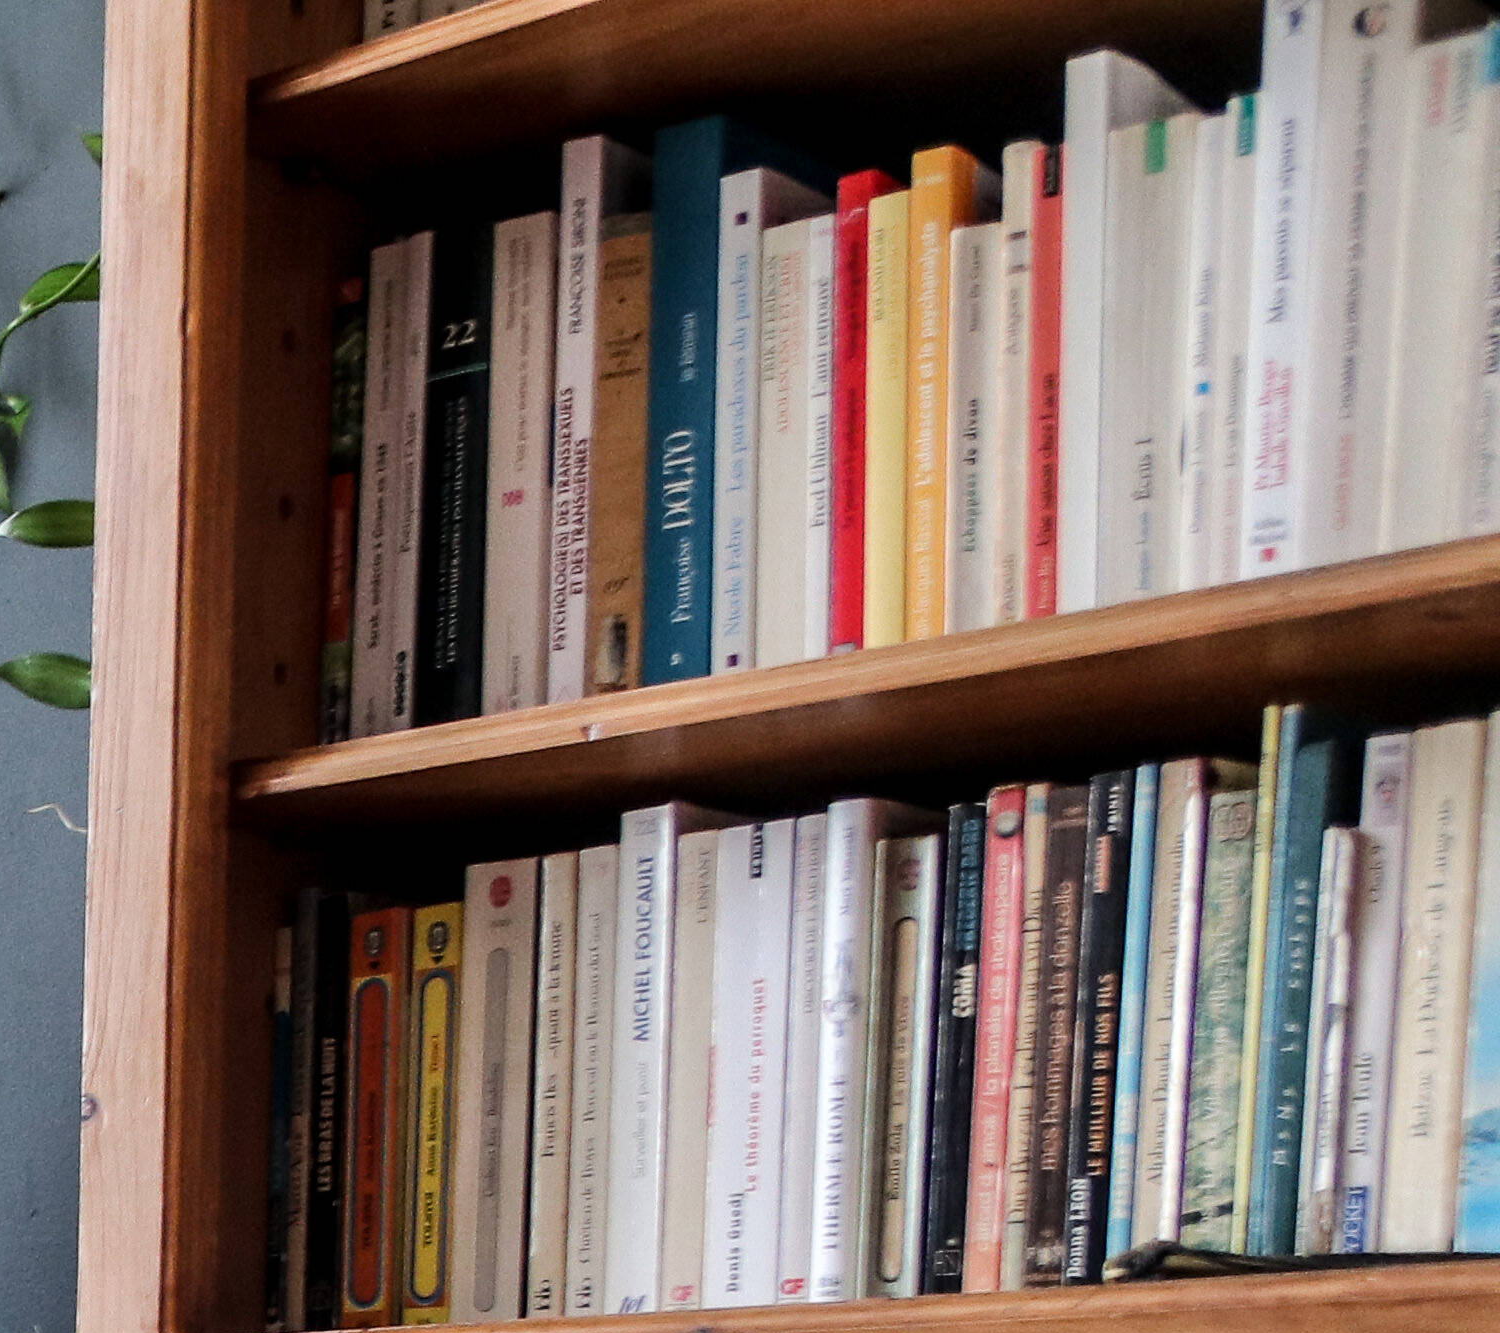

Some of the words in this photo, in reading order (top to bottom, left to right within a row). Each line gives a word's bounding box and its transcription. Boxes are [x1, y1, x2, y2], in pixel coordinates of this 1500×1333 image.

[1273, 118, 1297, 191] séparent
[572, 196, 588, 246] SIRONI
[1271, 197, 1292, 212] se
[1266, 220, 1290, 281] parents
[569, 251, 586, 333] FRANÇOISE
[731, 252, 751, 320] pardon
[1263, 290, 1285, 325] Mes
[441, 318, 477, 350] 22
[730, 327, 749, 351] du
[728, 357, 749, 453] paradoxes
[558, 387, 574, 494] TRANSSEXUELS
[573, 438, 589, 544] TRANSGENRES
[727, 460, 746, 491] Les
[557, 498, 571, 526] DES
[573, 549, 585, 575] DES
[725, 516, 745, 568] Fabre
[554, 531, 571, 650] PSYCHOLOGIE(S)
[572, 580, 584, 595] ET
[724, 574, 743, 637] Nicole
[1107, 786, 1121, 834] POINTS
[1426, 798, 1449, 889] Langeais
[635, 856, 654, 960] FOUCAULT
[698, 849, 712, 924] L'ENFANT
[1424, 902, 1442, 920] de
[1049, 879, 1072, 967] donzelle
[952, 964, 976, 1018] COMA
[1048, 971, 1067, 987] la
[1048, 991, 1065, 1004] à
[1098, 974, 1117, 1008] FILS
[1416, 932, 1440, 1025] Duchesse
[632, 969, 650, 1042] MICHEL
[749, 979, 764, 1057] perroquet
[1095, 1014, 1114, 1046] NOS
[1041, 1012, 1064, 1123] hommages
[1093, 1051, 1112, 1071] DE
[1414, 1032, 1434, 1055] La
[749, 1065, 761, 1083] du
[1151, 1043, 1171, 1101] Daudet
[1350, 1053, 1372, 1104] Teulé
[746, 1092, 760, 1166] théorème
[1088, 1077, 1110, 1153] MEILLEUR
[1411, 1073, 1431, 1136] Balzac
[1041, 1127, 1057, 1171] mes
[1146, 1111, 1168, 1184] Alphonse
[1348, 1112, 1369, 1154] Jean
[745, 1176, 758, 1192] Le
[1086, 1159, 1104, 1178] LE
[728, 1193, 744, 1240] Guedj
[1068, 1179, 1088, 1223] LEON
[726, 1247, 742, 1292] Denis
[1065, 1229, 1086, 1279] Donna
